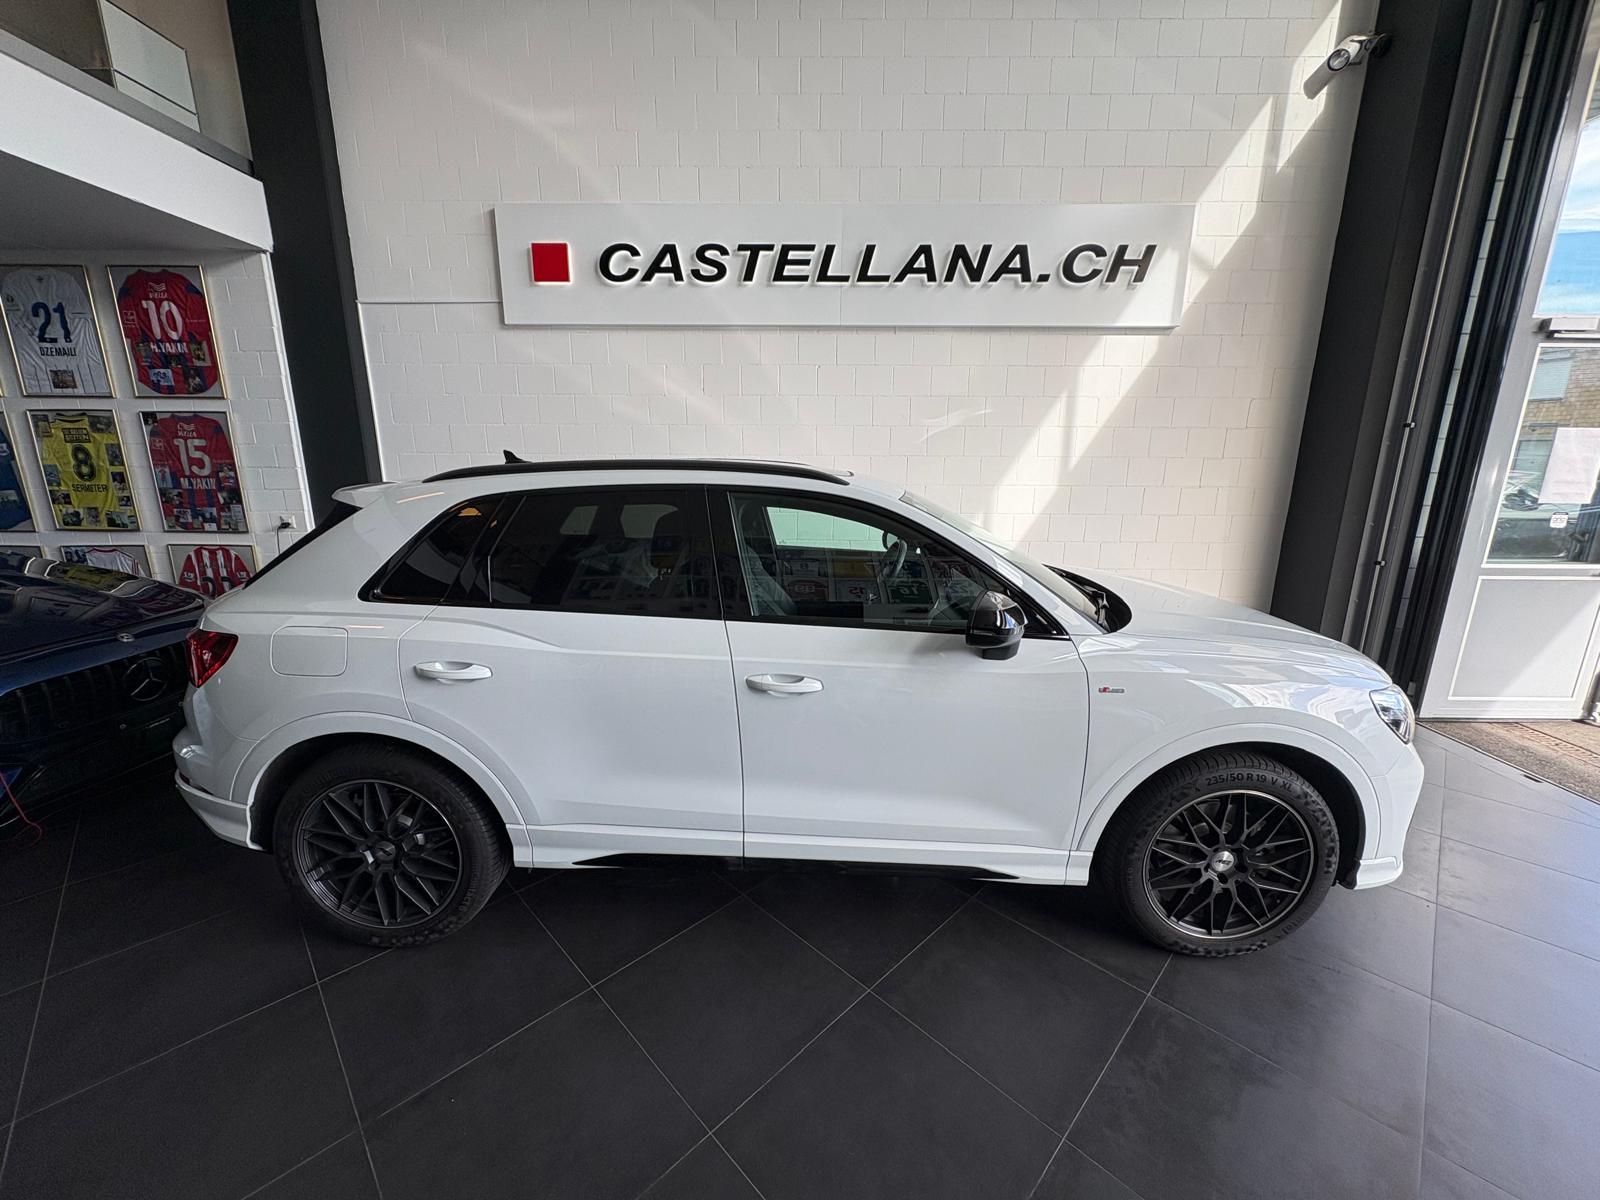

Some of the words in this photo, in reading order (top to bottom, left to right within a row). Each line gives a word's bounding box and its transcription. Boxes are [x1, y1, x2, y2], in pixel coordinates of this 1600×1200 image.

[598, 243, 1157, 284] CASTELLANA.CH
[31, 301, 73, 343] 21
[141, 299, 183, 341] 10
[71, 444, 98, 482] 8
[173, 438, 213, 477] 15
[1205, 772, 1244, 786] 235/50
[1246, 772, 1254, 782] R
[1256, 774, 1267, 783] 19
[1271, 776, 1279, 785] V
[1280, 780, 1293, 792] XL
